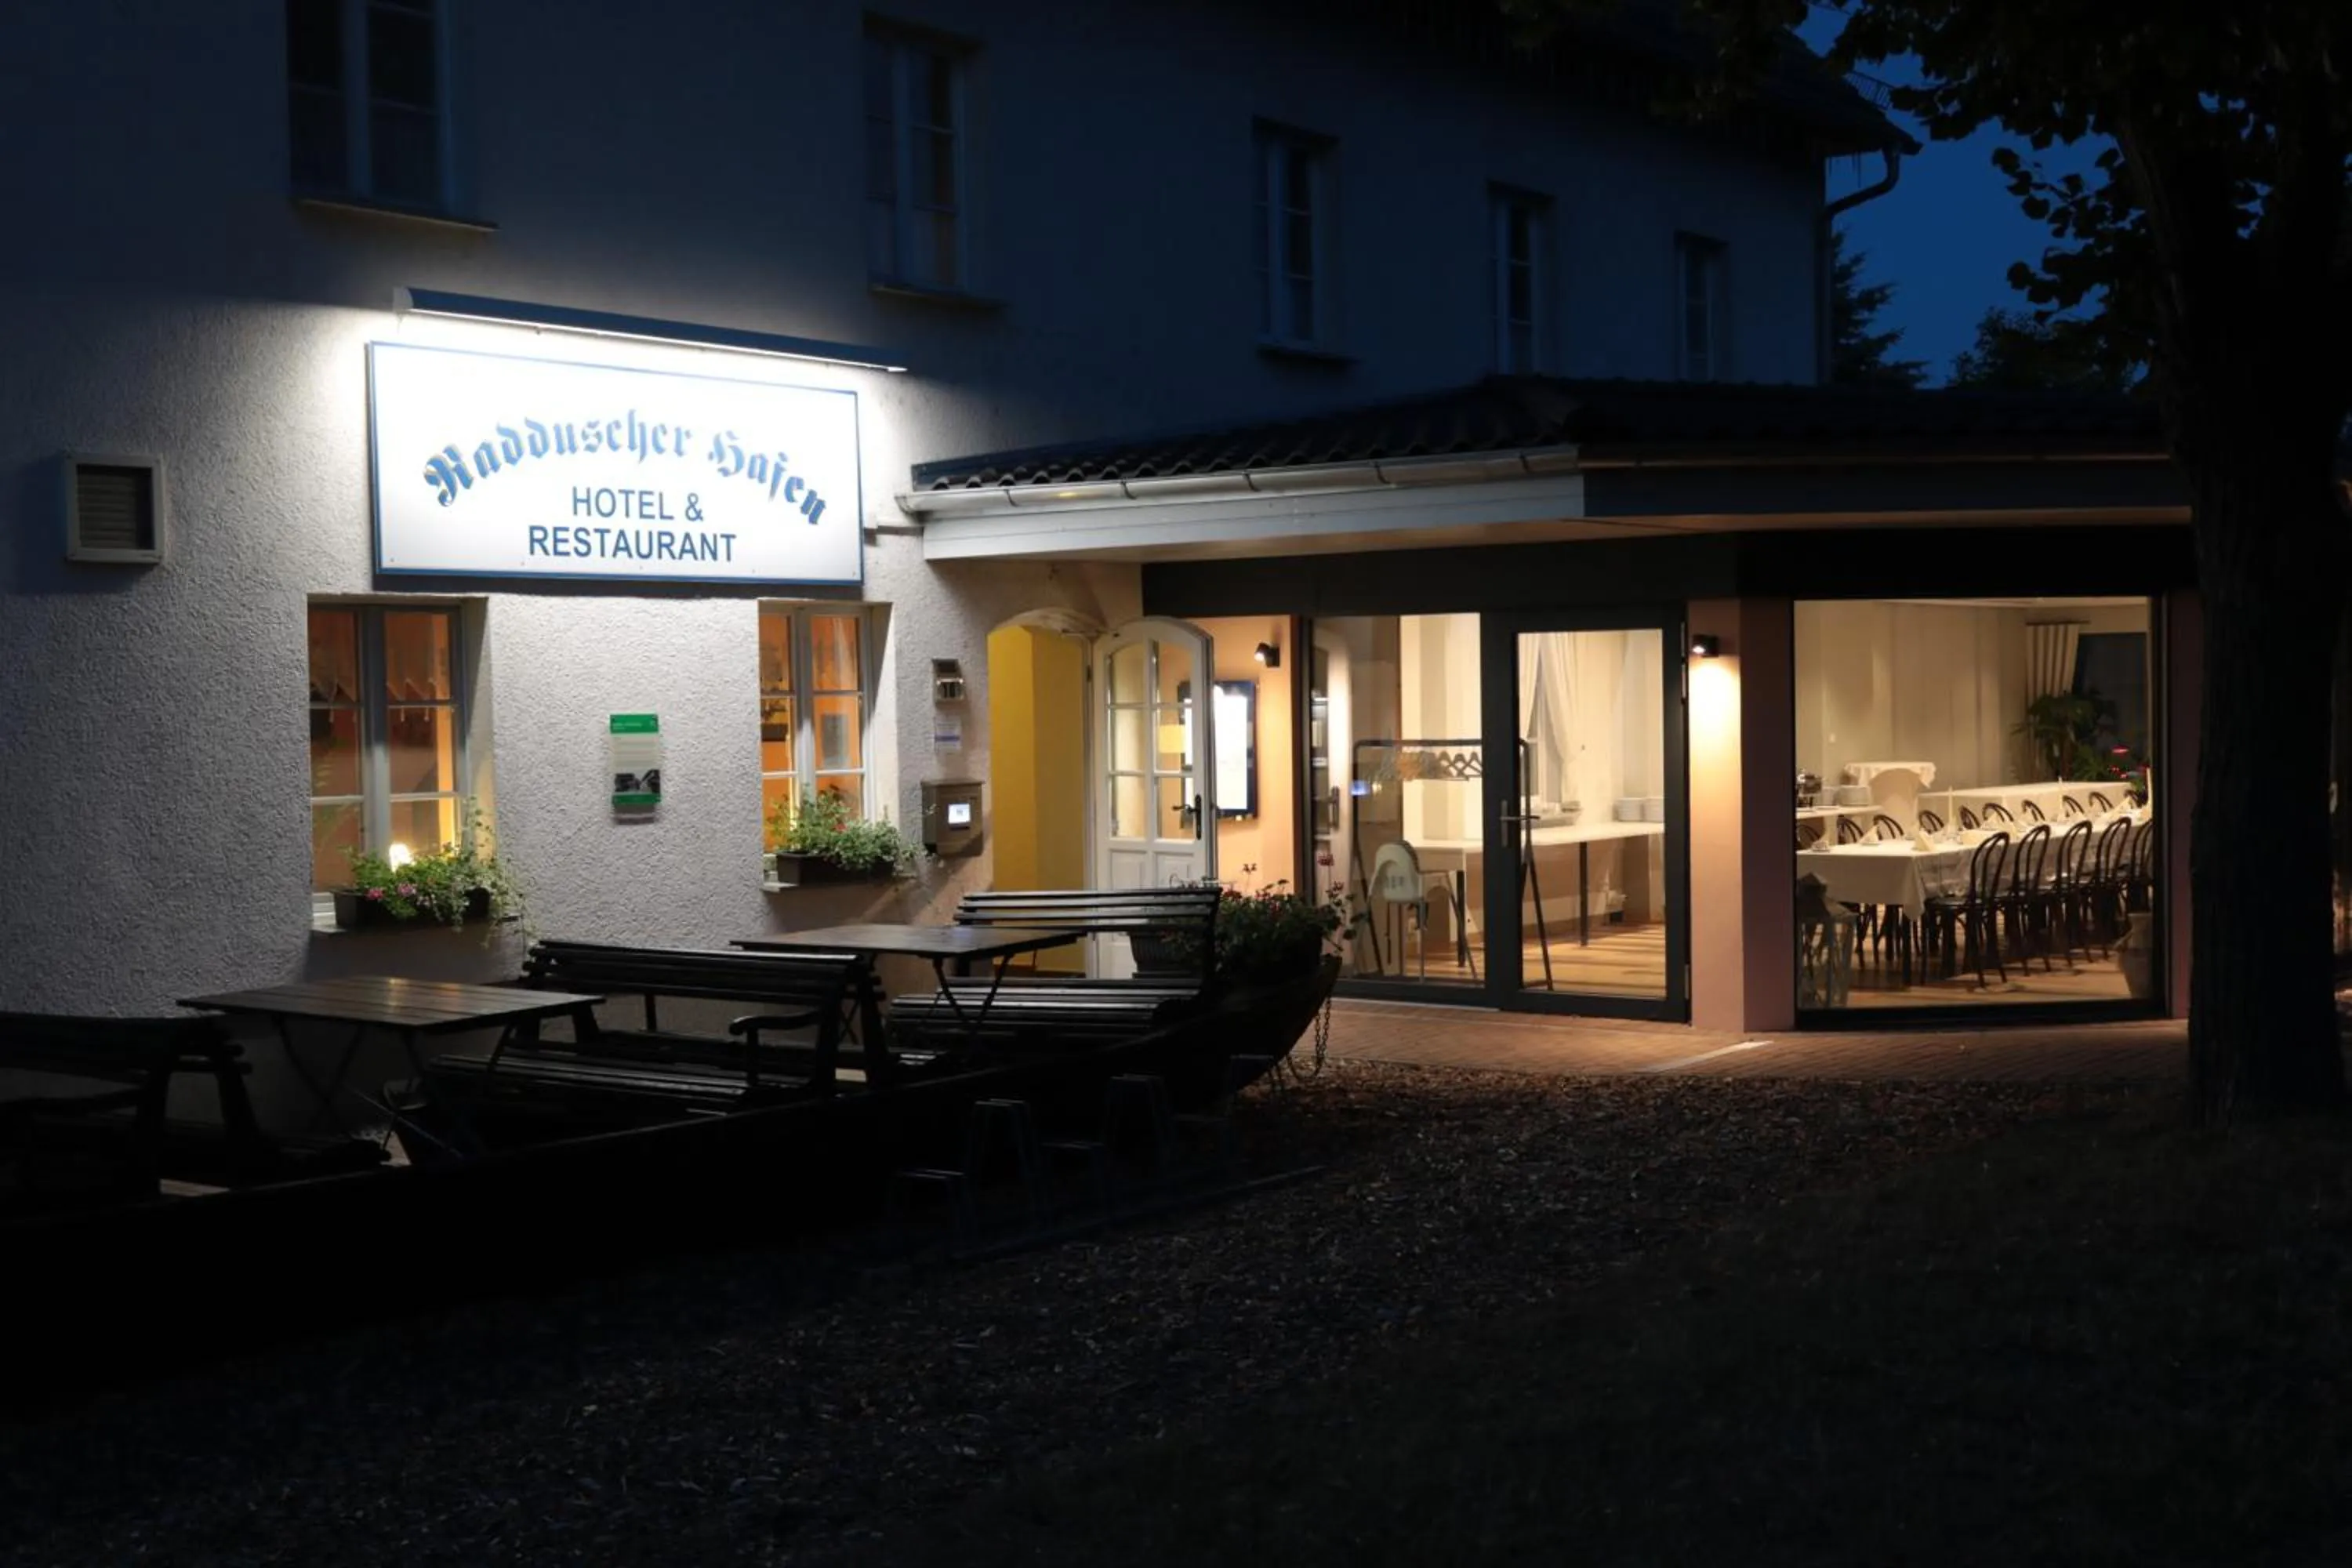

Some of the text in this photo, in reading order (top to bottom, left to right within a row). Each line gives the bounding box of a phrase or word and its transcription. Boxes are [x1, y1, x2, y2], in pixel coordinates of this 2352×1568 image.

[423, 408, 827, 524] Radduscher Hafen
[572, 486, 703, 521] HOTEL &
[529, 525, 736, 561] RESTAURANT
